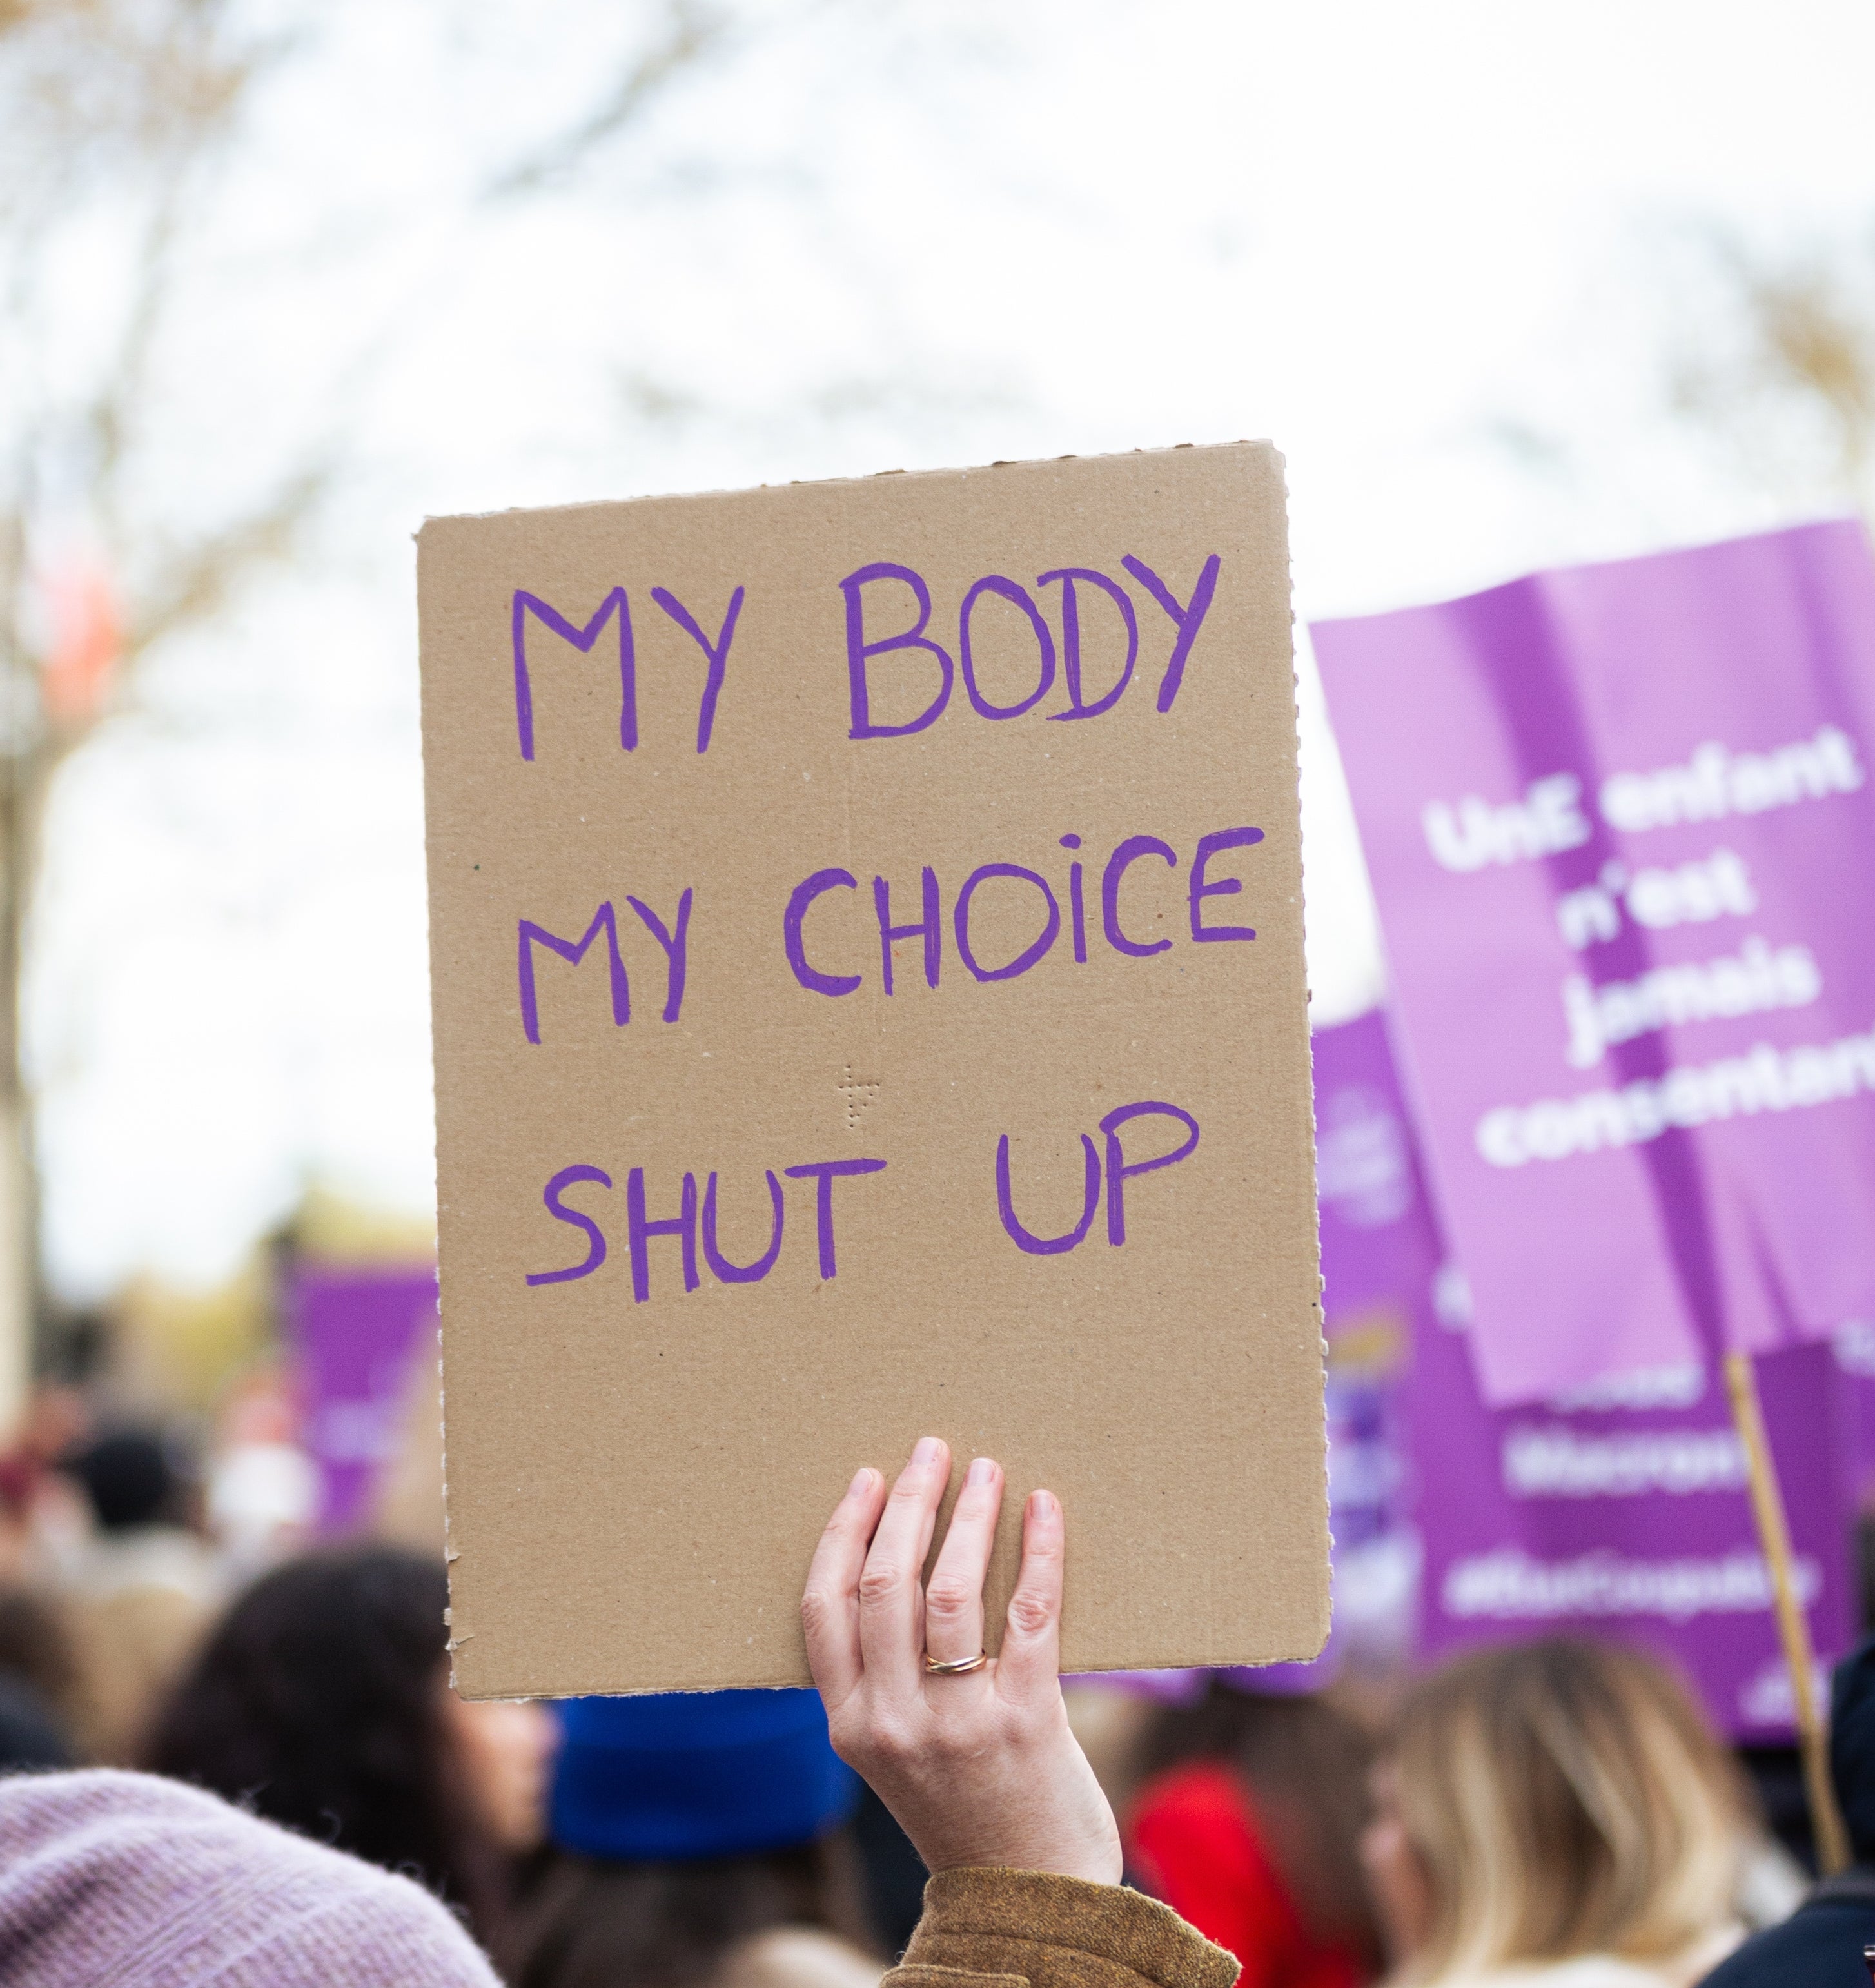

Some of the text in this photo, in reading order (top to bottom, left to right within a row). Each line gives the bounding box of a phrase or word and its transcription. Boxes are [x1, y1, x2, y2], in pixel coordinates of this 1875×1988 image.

[513, 555, 1220, 760] MY BODY
[1602, 730, 1860, 831] enfant
[518, 888, 692, 1043] MY
[1564, 938, 1818, 1067] jamais
[526, 1159, 887, 1303] SHUT
[996, 1101, 1199, 1255] UP
